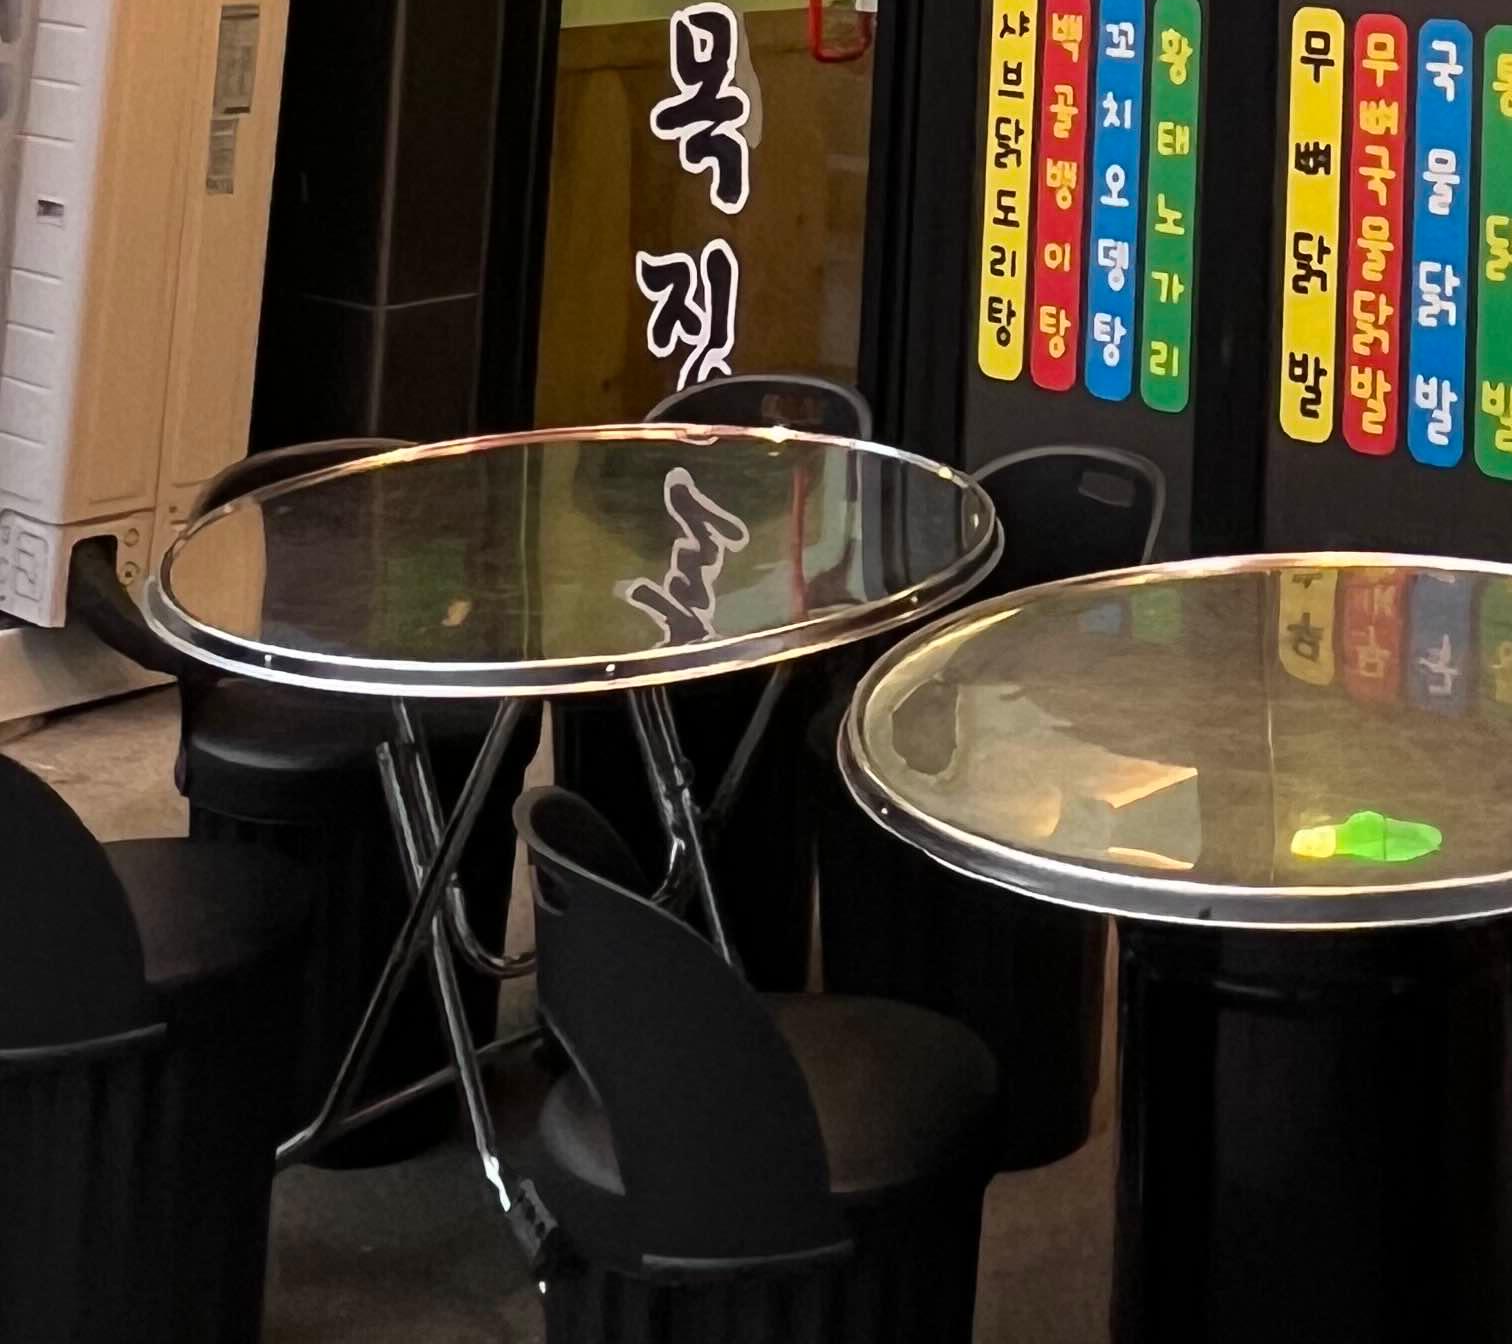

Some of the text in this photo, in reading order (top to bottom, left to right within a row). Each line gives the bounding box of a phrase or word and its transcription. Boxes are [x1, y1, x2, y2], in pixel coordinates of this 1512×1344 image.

[986, 11, 1031, 347] 샤브닭도리탕
[1038, 12, 1085, 359] 백골뱅이탕
[1092, 21, 1135, 368] 꼬치오뎅탕
[1149, 27, 1193, 378] 황태노가리
[1287, 30, 1335, 420] 무뼈닭발
[1350, 32, 1400, 435] 무뼈국물닭발
[1415, 39, 1464, 447] 국물닭발
